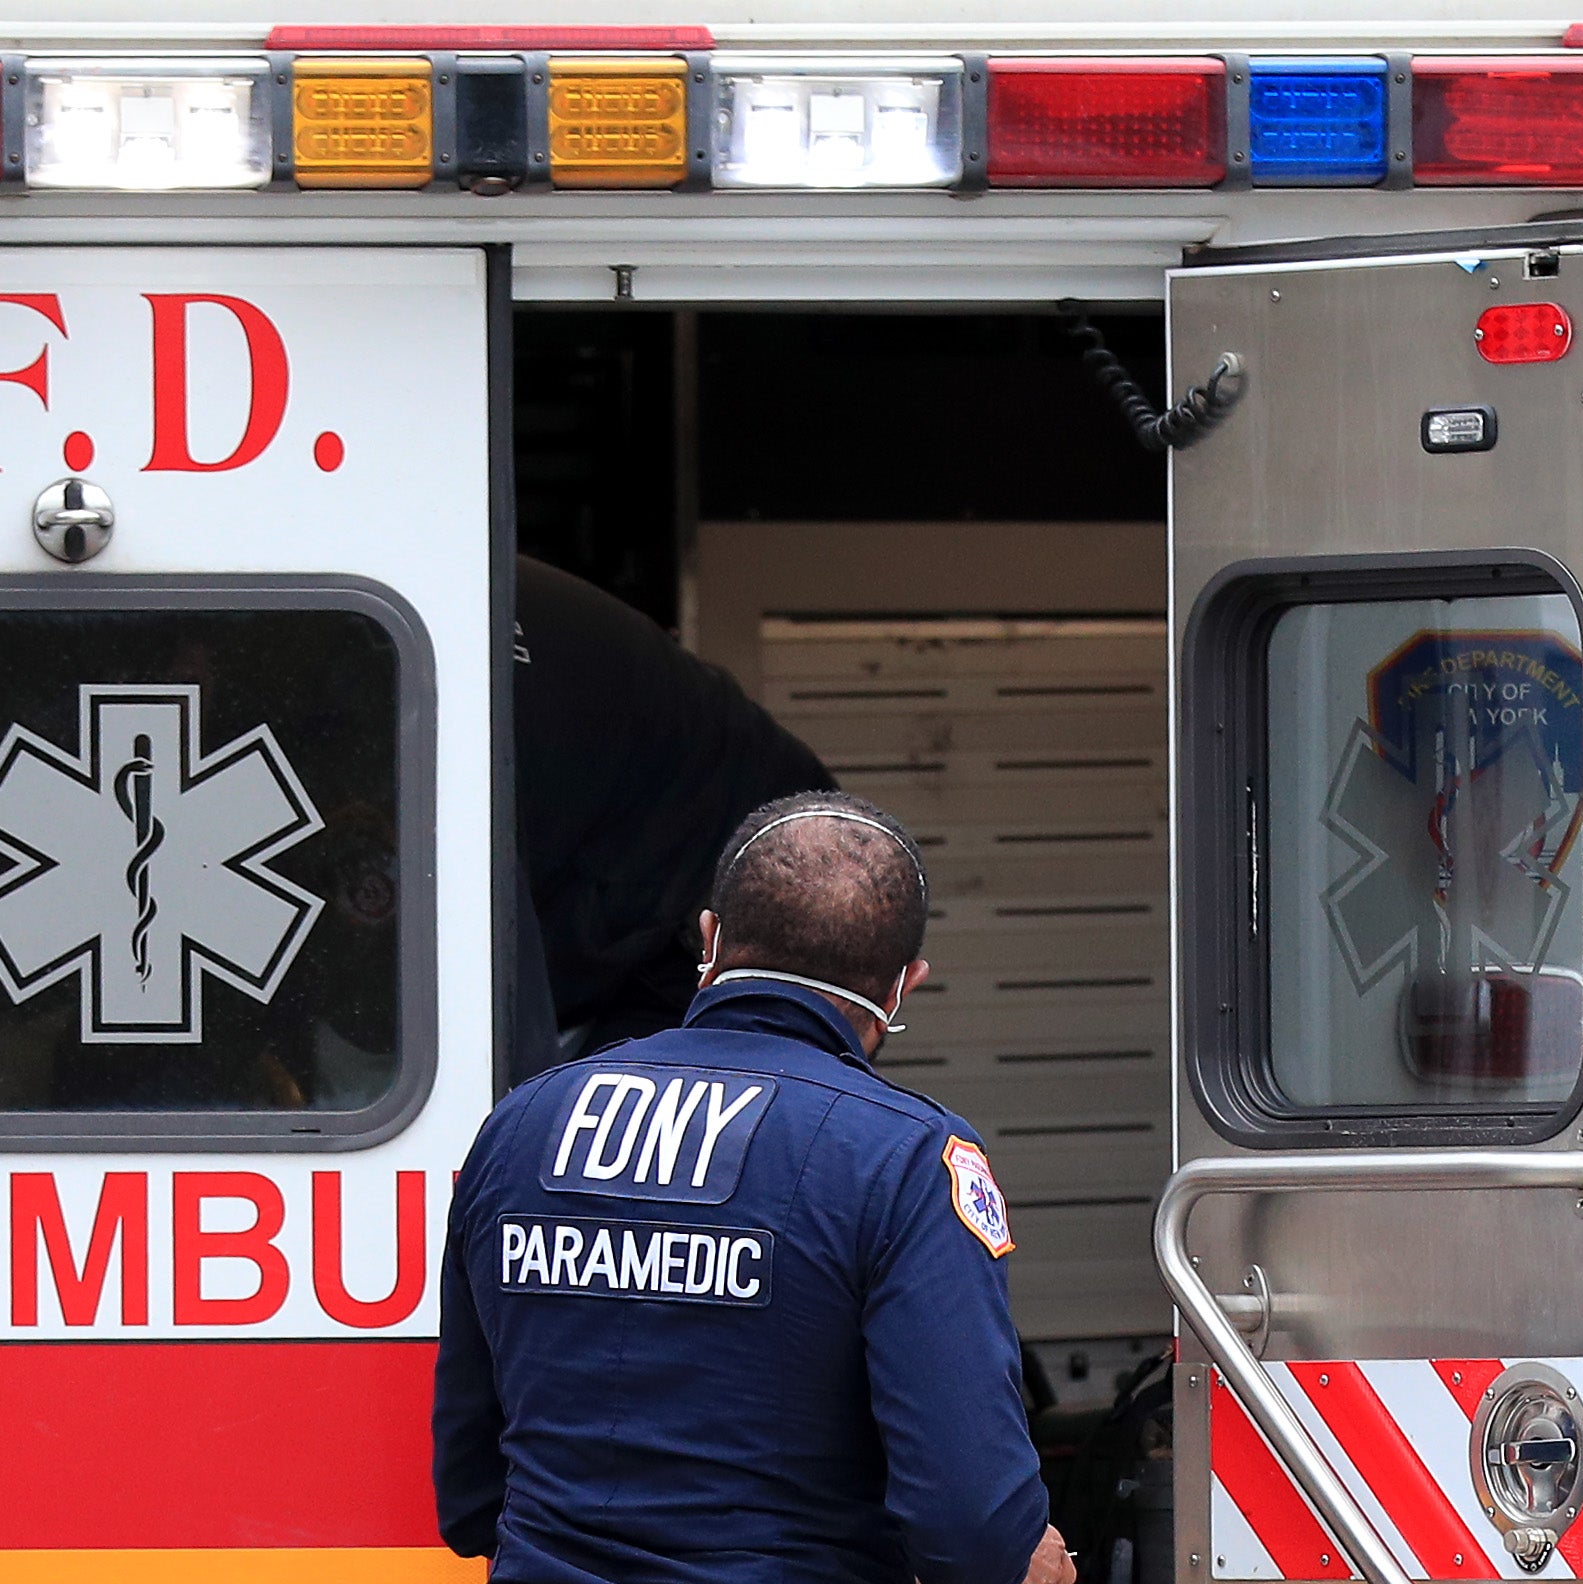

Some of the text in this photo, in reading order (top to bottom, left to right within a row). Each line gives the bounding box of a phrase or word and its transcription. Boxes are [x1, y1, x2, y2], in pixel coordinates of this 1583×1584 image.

[1502, 684, 1531, 700] OF
[552, 1072, 762, 1188] FDNY
[502, 1223, 762, 1299] PARAMEDIC
